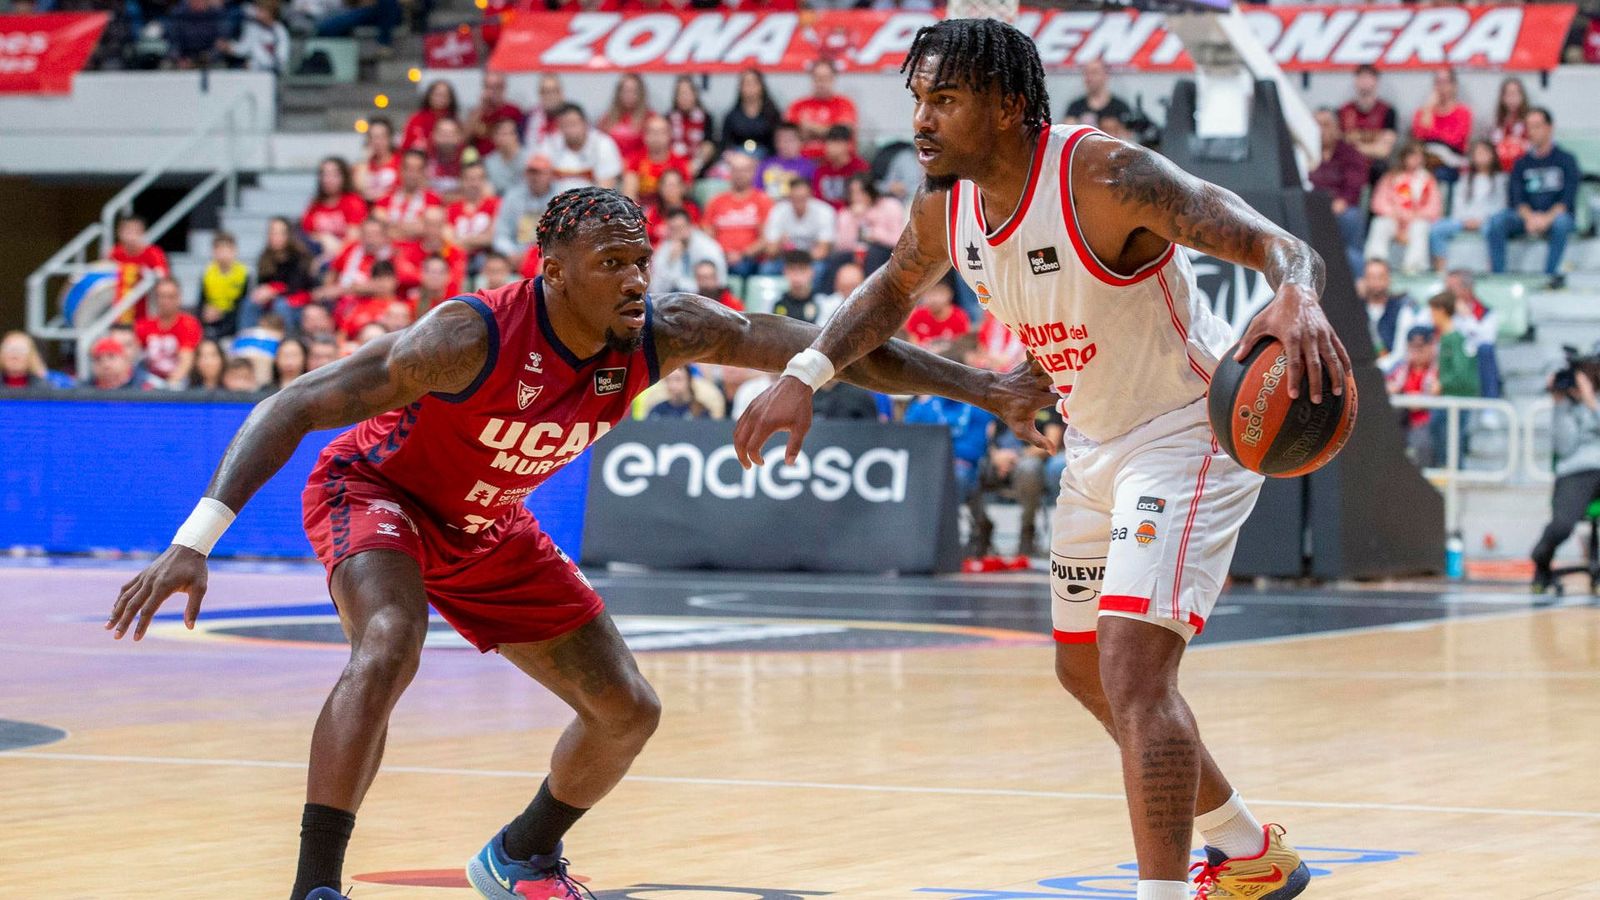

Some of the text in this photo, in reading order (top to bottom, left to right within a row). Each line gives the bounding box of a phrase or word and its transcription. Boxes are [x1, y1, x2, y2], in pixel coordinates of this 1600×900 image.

[540, 13, 798, 65] ZONA
[1031, 257, 1044, 267] liga
[1033, 262, 1059, 272] endesa
[1069, 324, 1088, 340] del
[598, 377, 611, 386] liga
[1241, 347, 1288, 447] liga endes
[489, 451, 581, 475] MUR
[602, 442, 909, 502] endesa
[1138, 502, 1159, 511] acb
[1110, 527, 1128, 541] ea
